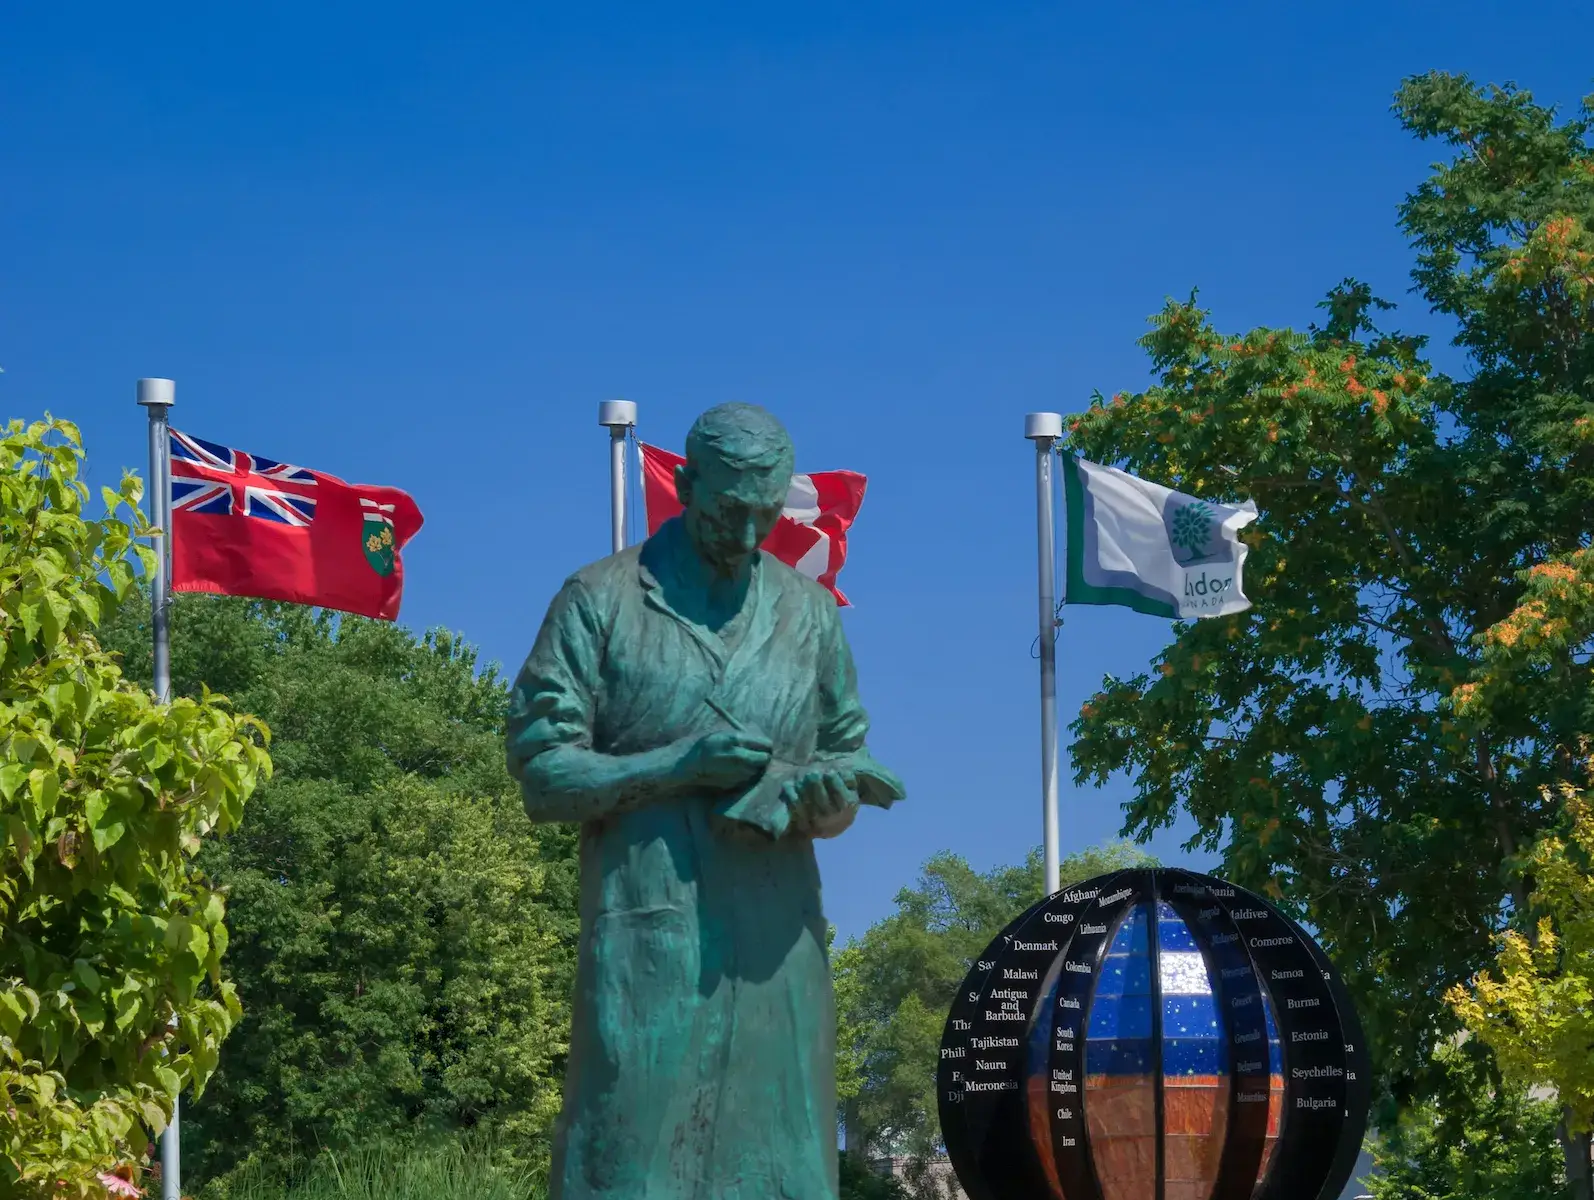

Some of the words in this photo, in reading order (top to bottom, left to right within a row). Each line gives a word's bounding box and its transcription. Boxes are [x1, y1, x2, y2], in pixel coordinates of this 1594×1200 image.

[1098, 887, 1133, 908] Mozambique
[1044, 913, 1074, 925] Congo
[1080, 923, 1107, 935] Lithuania
[1014, 940, 1058, 951] Denmark
[1250, 936, 1293, 948] Comoros
[1065, 961, 1091, 974] Colombia
[1003, 968, 1038, 980] Malawi
[1271, 969, 1304, 980] Samoa
[990, 988, 1028, 1001] Antigua
[1001, 1000, 1019, 1011] and
[1059, 997, 1080, 1010] Canada
[1287, 998, 1320, 1009] Burma
[985, 1010, 1026, 1021] Barbuda
[1057, 1027, 1074, 1038] South
[1291, 1029, 1329, 1042] Estonia
[971, 1036, 1019, 1050] Tajikistan
[1057, 1041, 1073, 1052] Korea
[976, 1060, 1007, 1071] Nauru
[1053, 1070, 1073, 1081] United
[1292, 1066, 1343, 1080] Seychelles
[965, 1080, 1018, 1092] Micronesia
[1051, 1081, 1077, 1094] Kingdom
[1296, 1097, 1337, 1110] Bulgaria
[1057, 1109, 1073, 1119] Chile
[1062, 1136, 1076, 1147] Iran
